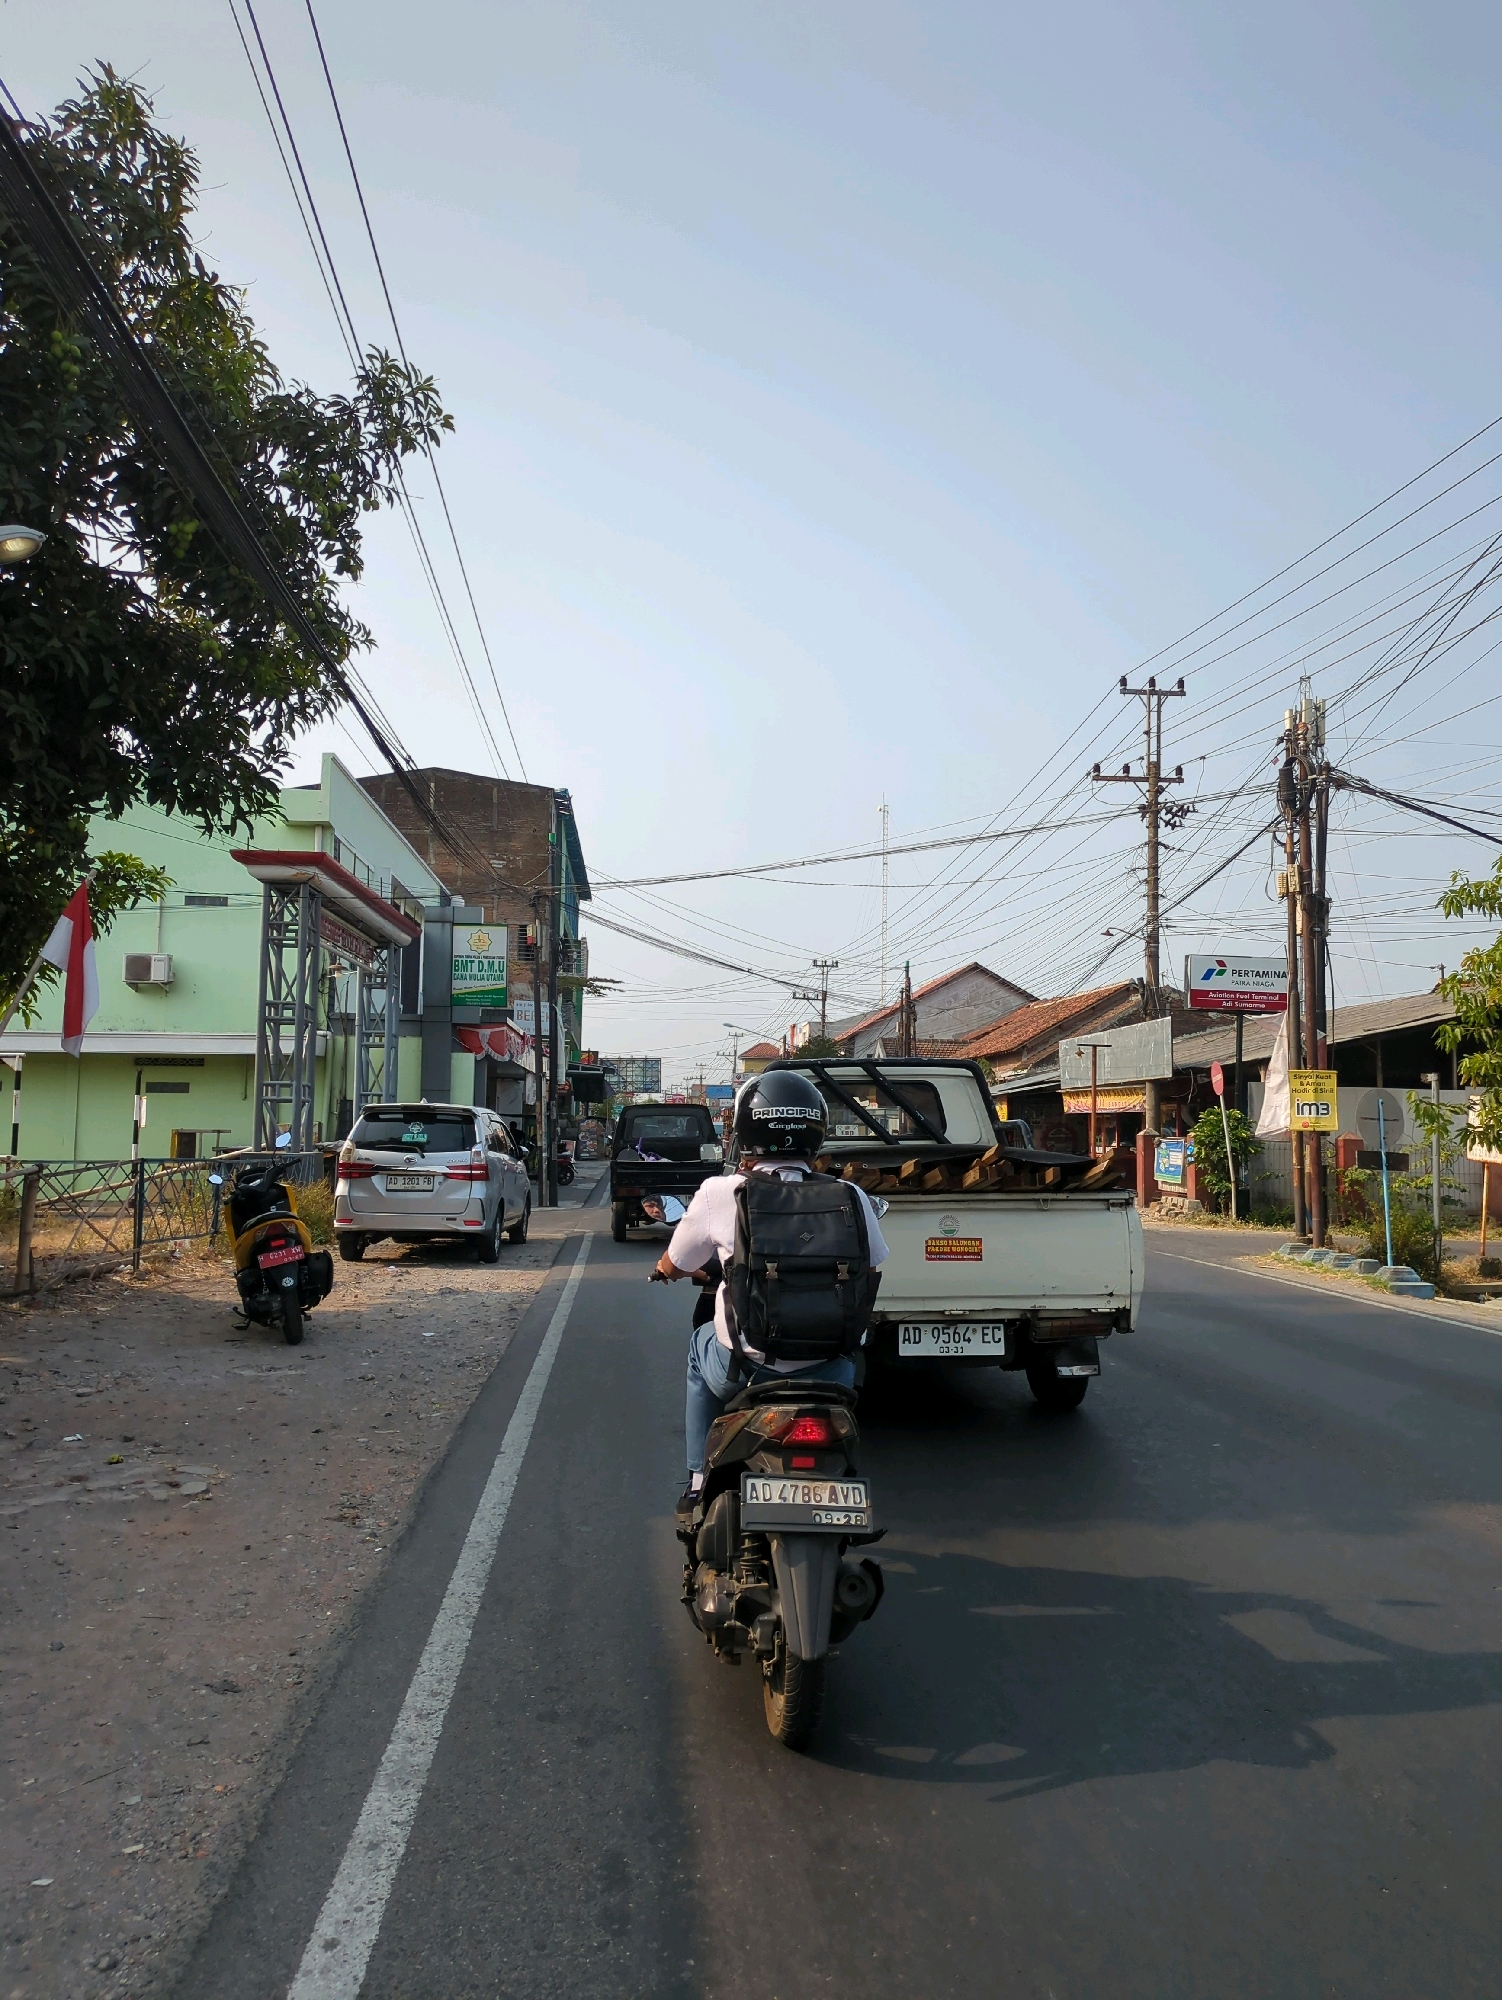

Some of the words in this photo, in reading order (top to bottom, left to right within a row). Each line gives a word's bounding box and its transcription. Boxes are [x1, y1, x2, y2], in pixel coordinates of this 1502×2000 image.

[453, 959, 475, 973] BMT
[477, 960, 505, 973] D.M.U
[453, 973, 467, 981] DANA
[1231, 969, 1288, 979] PERTAMINA
[1251, 993, 1279, 1001] Terminal
[752, 1106, 821, 1120] PRINCIPLE
[388, 1176, 398, 1186] AD
[402, 1176, 420, 1186] 1201
[423, 1176, 432, 1186] FB
[901, 1326, 922, 1345] AD
[931, 1326, 972, 1344] 9564
[981, 1326, 1002, 1344] EC
[749, 1482, 772, 1502] AD
[777, 1483, 823, 1503] 4786
[827, 1485, 863, 1505] AVD
